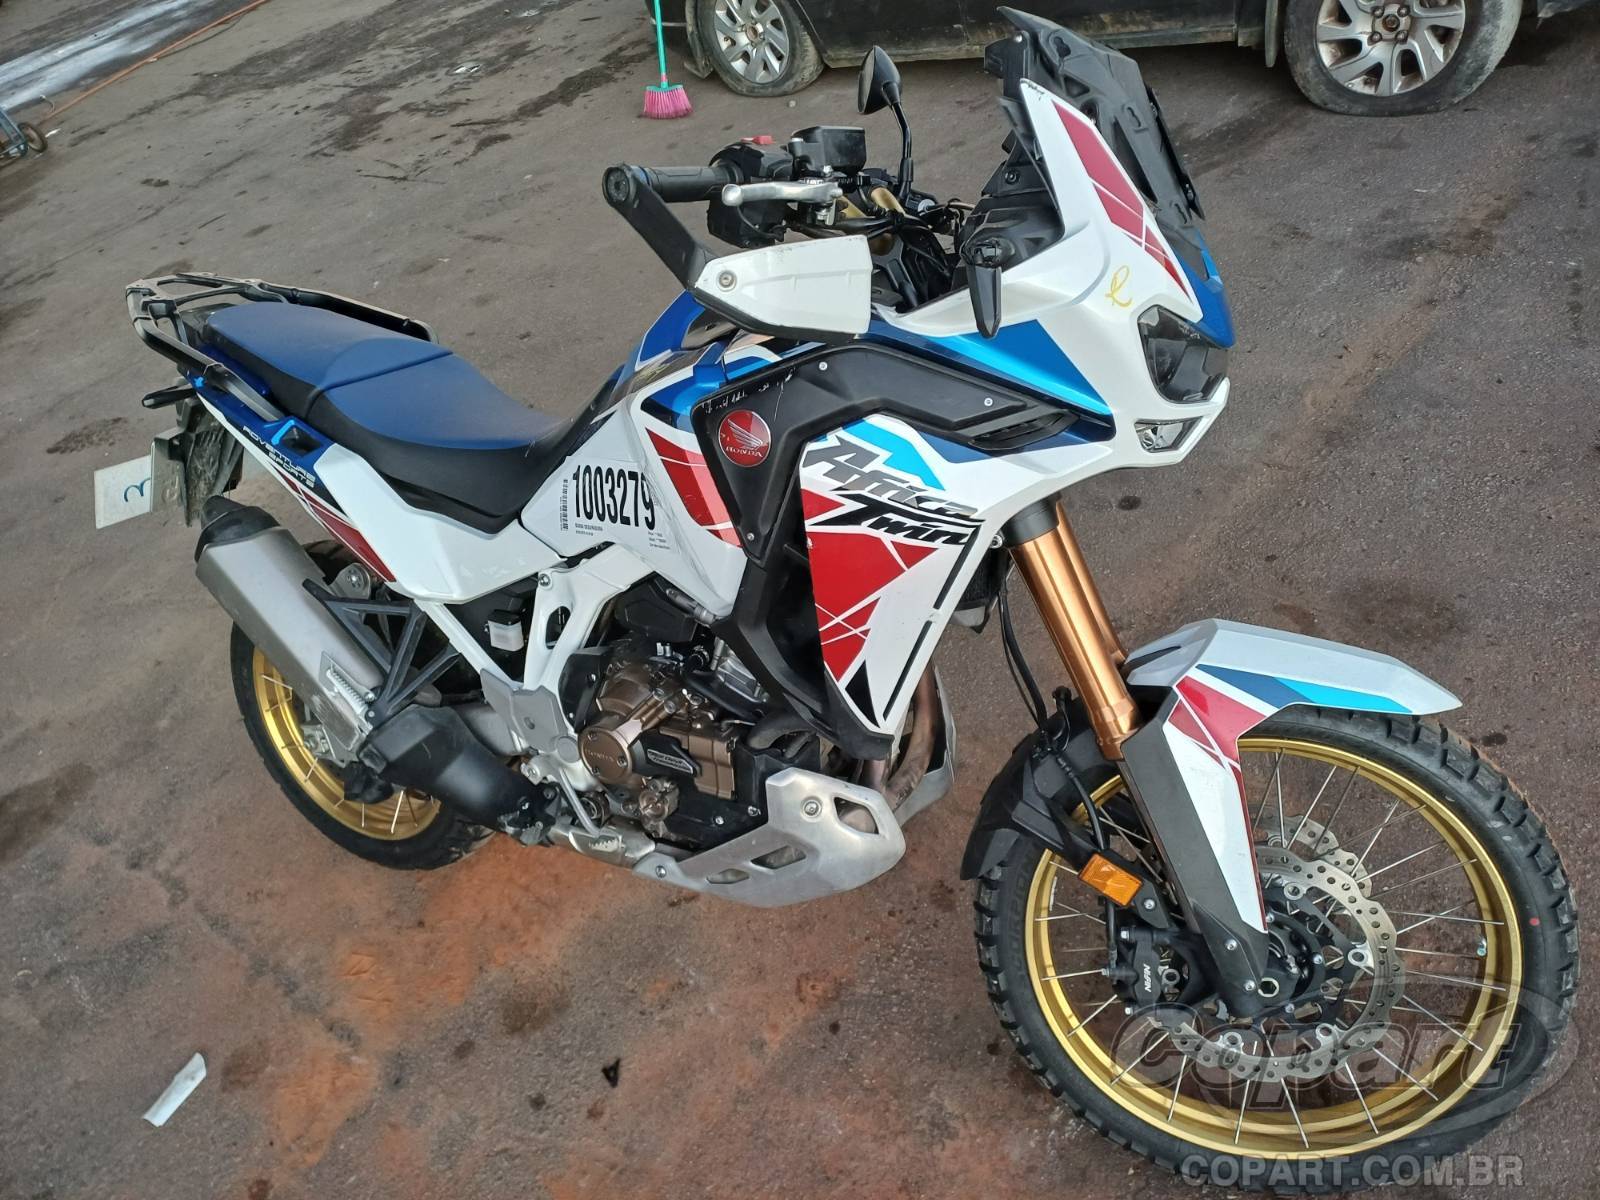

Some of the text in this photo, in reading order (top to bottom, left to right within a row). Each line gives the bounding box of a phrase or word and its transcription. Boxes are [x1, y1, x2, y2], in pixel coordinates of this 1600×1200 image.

[268, 452, 315, 488] SPORTS
[725, 446, 763, 458] HONDA
[802, 435, 980, 517] Africa
[572, 465, 656, 531] 1003279
[810, 493, 981, 546] Twin
